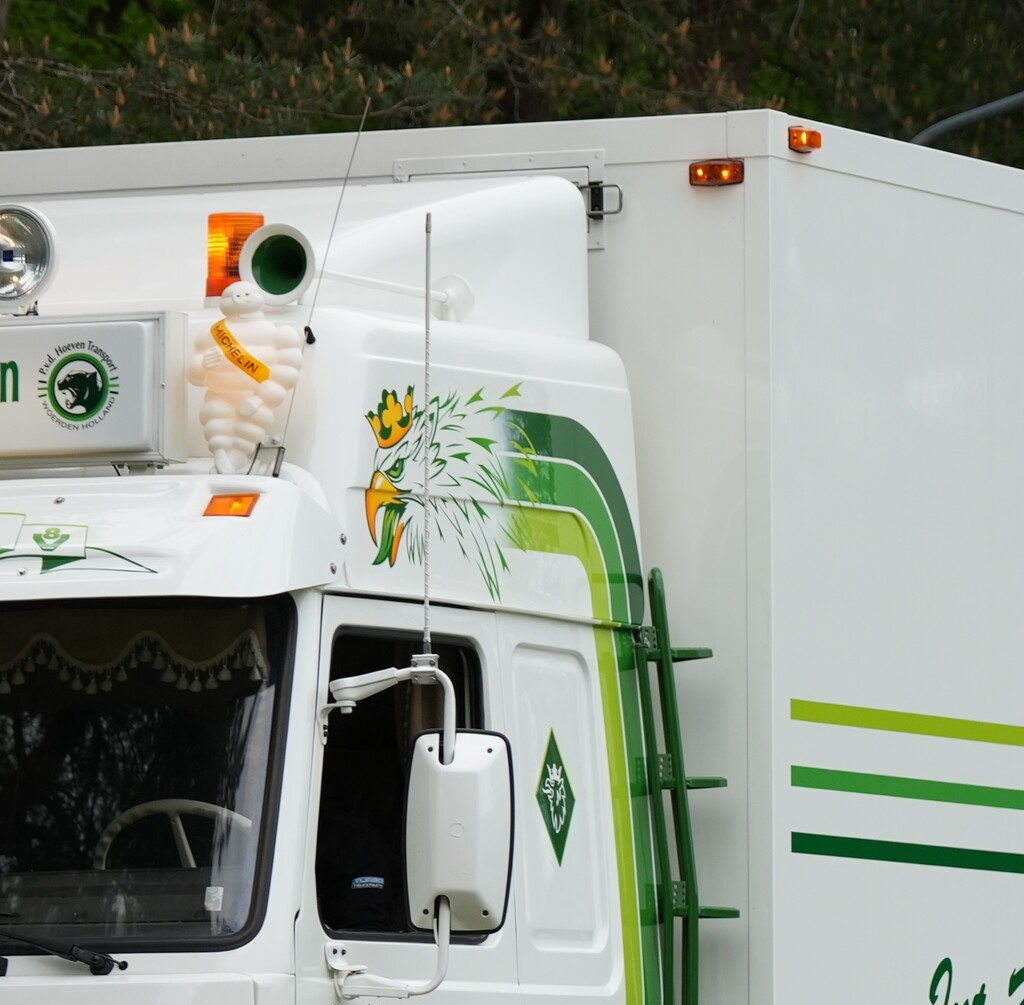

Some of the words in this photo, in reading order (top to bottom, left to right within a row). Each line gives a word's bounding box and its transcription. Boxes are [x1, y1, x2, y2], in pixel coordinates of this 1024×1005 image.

[54, 340, 86, 357] Hoeven
[87, 339, 119, 372] Transport
[214, 325, 259, 374] MICHELIN
[41, 399, 80, 431] WOERDEN
[81, 396, 116, 430] HOLLAND
